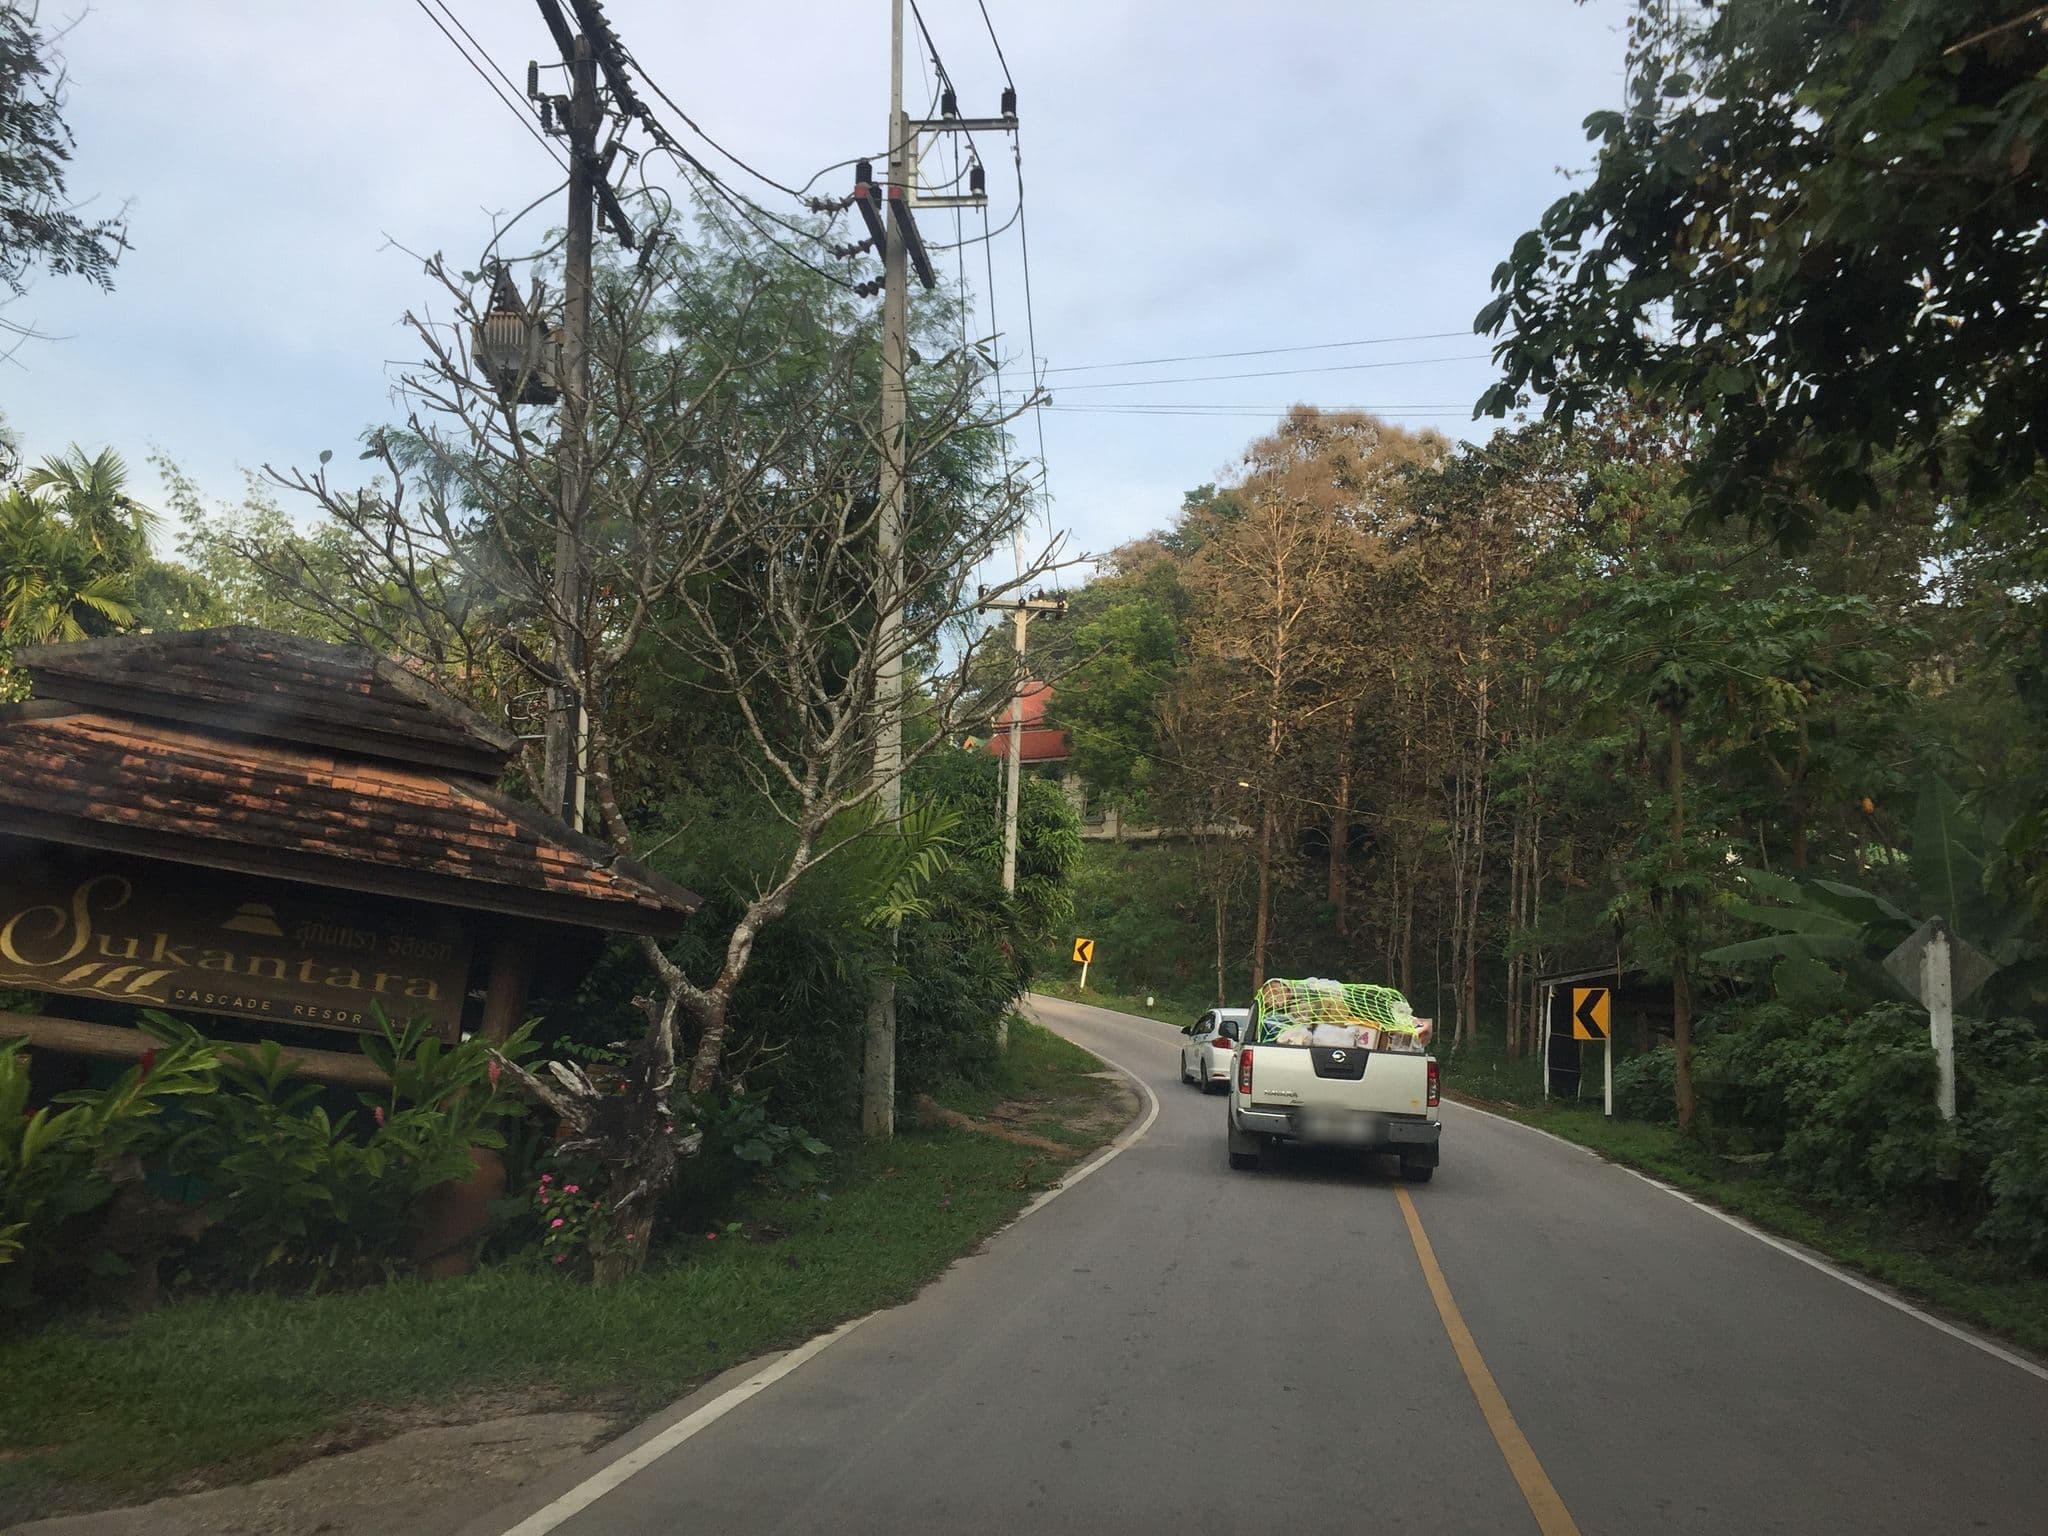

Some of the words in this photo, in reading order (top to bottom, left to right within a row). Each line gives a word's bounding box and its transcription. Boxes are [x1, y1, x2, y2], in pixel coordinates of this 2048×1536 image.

[0, 874, 440, 1001] Sukantara
[175, 989, 272, 1010] CASCADE
[294, 1005, 372, 1027] RESOR
